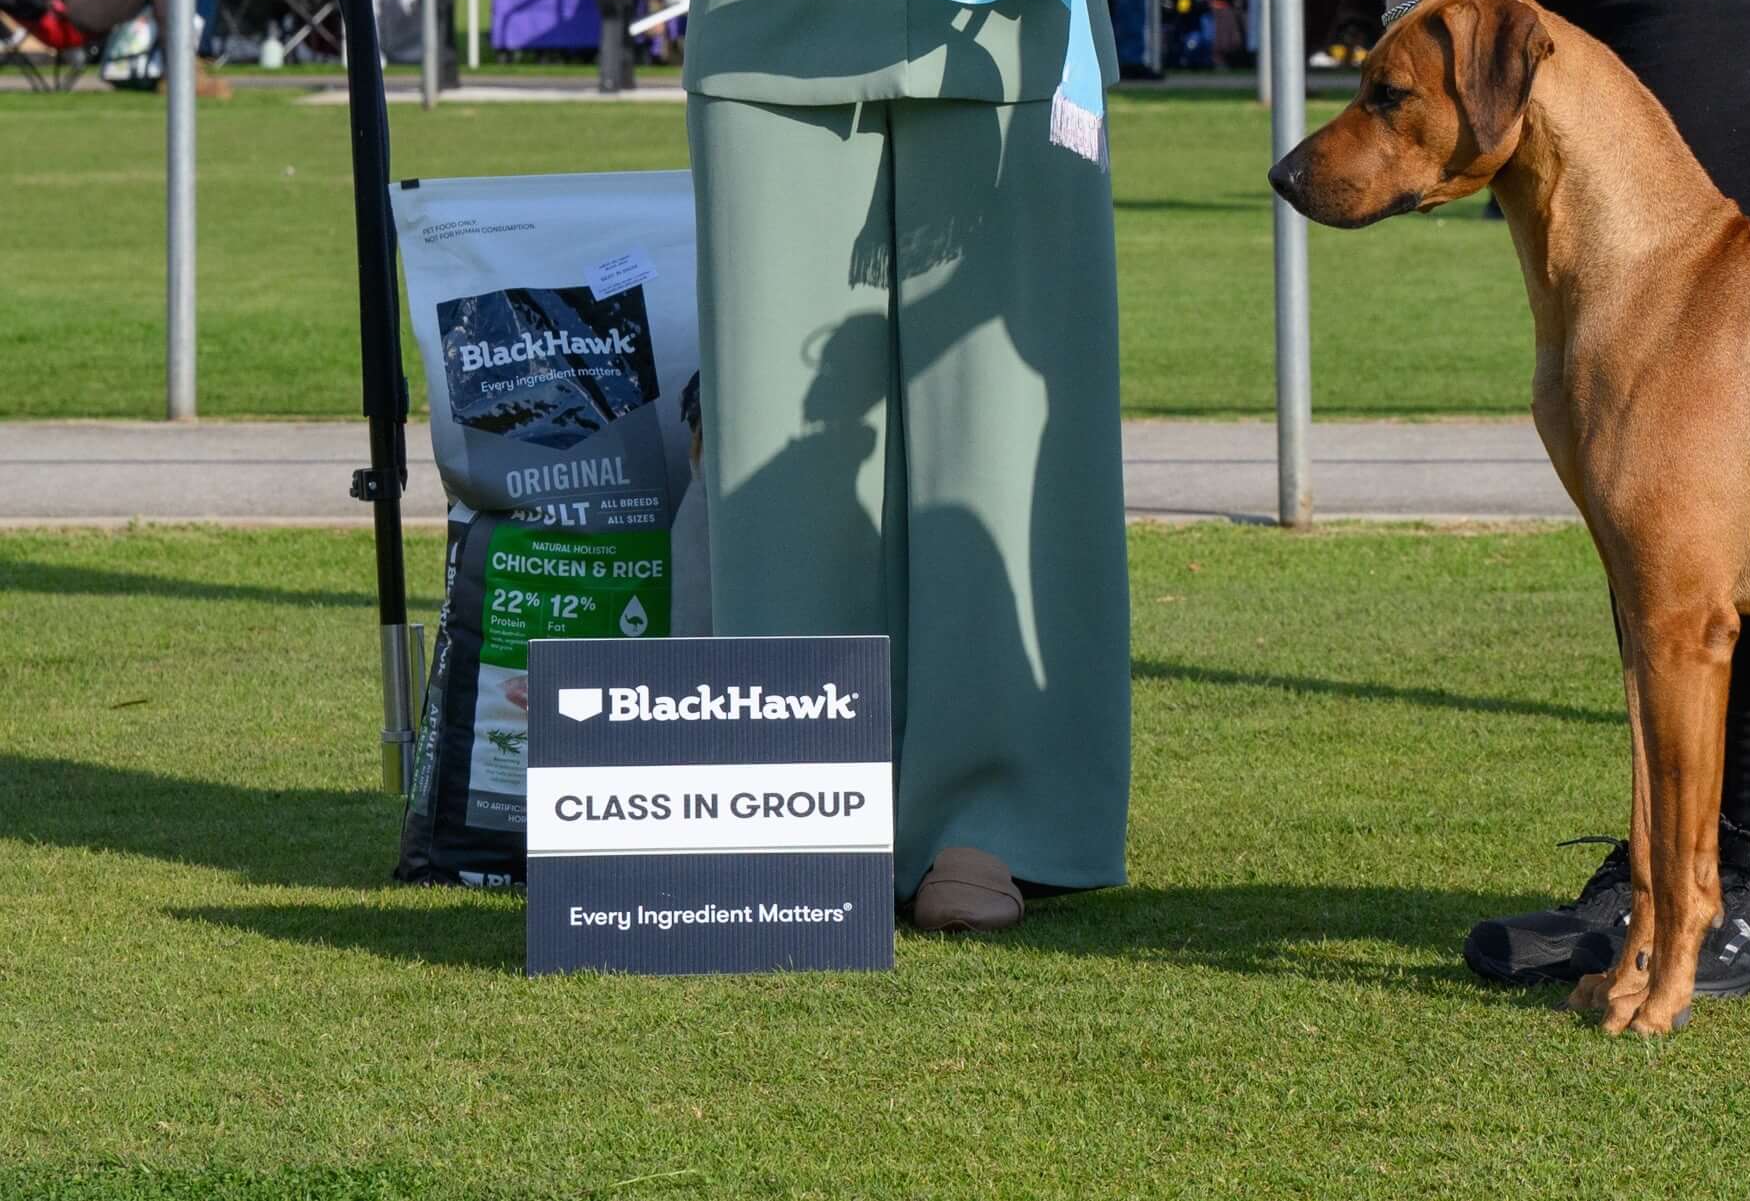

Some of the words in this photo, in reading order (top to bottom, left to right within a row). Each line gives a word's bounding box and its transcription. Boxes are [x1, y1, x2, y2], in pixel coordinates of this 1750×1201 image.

[435, 221, 457, 232] FOOD
[481, 223, 535, 234] CONSUMPTION
[481, 378, 514, 393] Every
[515, 368, 576, 386] ingredient
[578, 366, 621, 377] matters
[506, 456, 631, 498] ORIGINAL
[600, 500, 618, 510] ALL
[620, 497, 659, 508] BREEDS
[608, 515, 625, 525] ALL
[626, 514, 655, 524] SIZES
[532, 541, 571, 553] NATURAL
[573, 544, 617, 555] HOLISTIC
[492, 551, 586, 577] CHICKEN
[592, 560, 607, 577] &
[613, 560, 663, 579] RICE
[491, 588, 540, 614] 22%
[550, 593, 596, 619] 12%
[490, 615, 526, 629] Protein
[547, 620, 566, 633] Fat
[476, 800, 490, 809] NO
[554, 793, 672, 822] CLASS
[683, 793, 719, 820] IN
[729, 790, 866, 819] GROUP
[570, 906, 631, 930] Every
[638, 904, 753, 930] Ingredient
